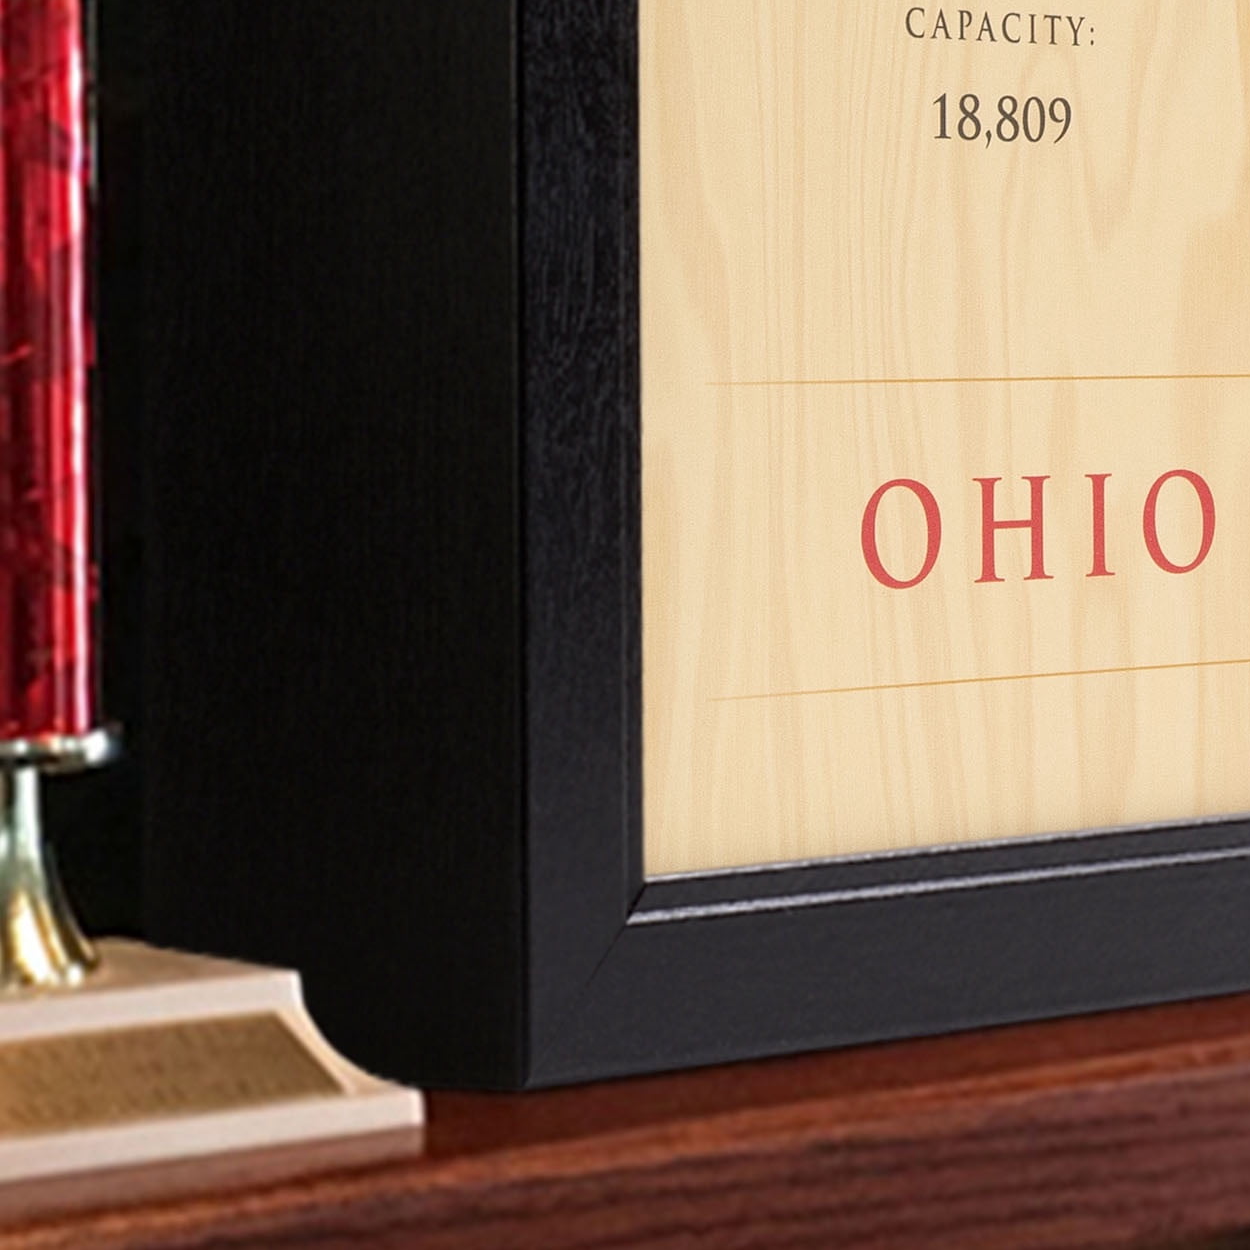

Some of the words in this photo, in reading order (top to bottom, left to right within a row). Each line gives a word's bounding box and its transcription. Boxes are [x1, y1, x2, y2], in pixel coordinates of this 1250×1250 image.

[904, 6, 1096, 47] CAPACITY:
[932, 91, 1073, 149] 18,809
[860, 469, 1217, 590] OHIO
